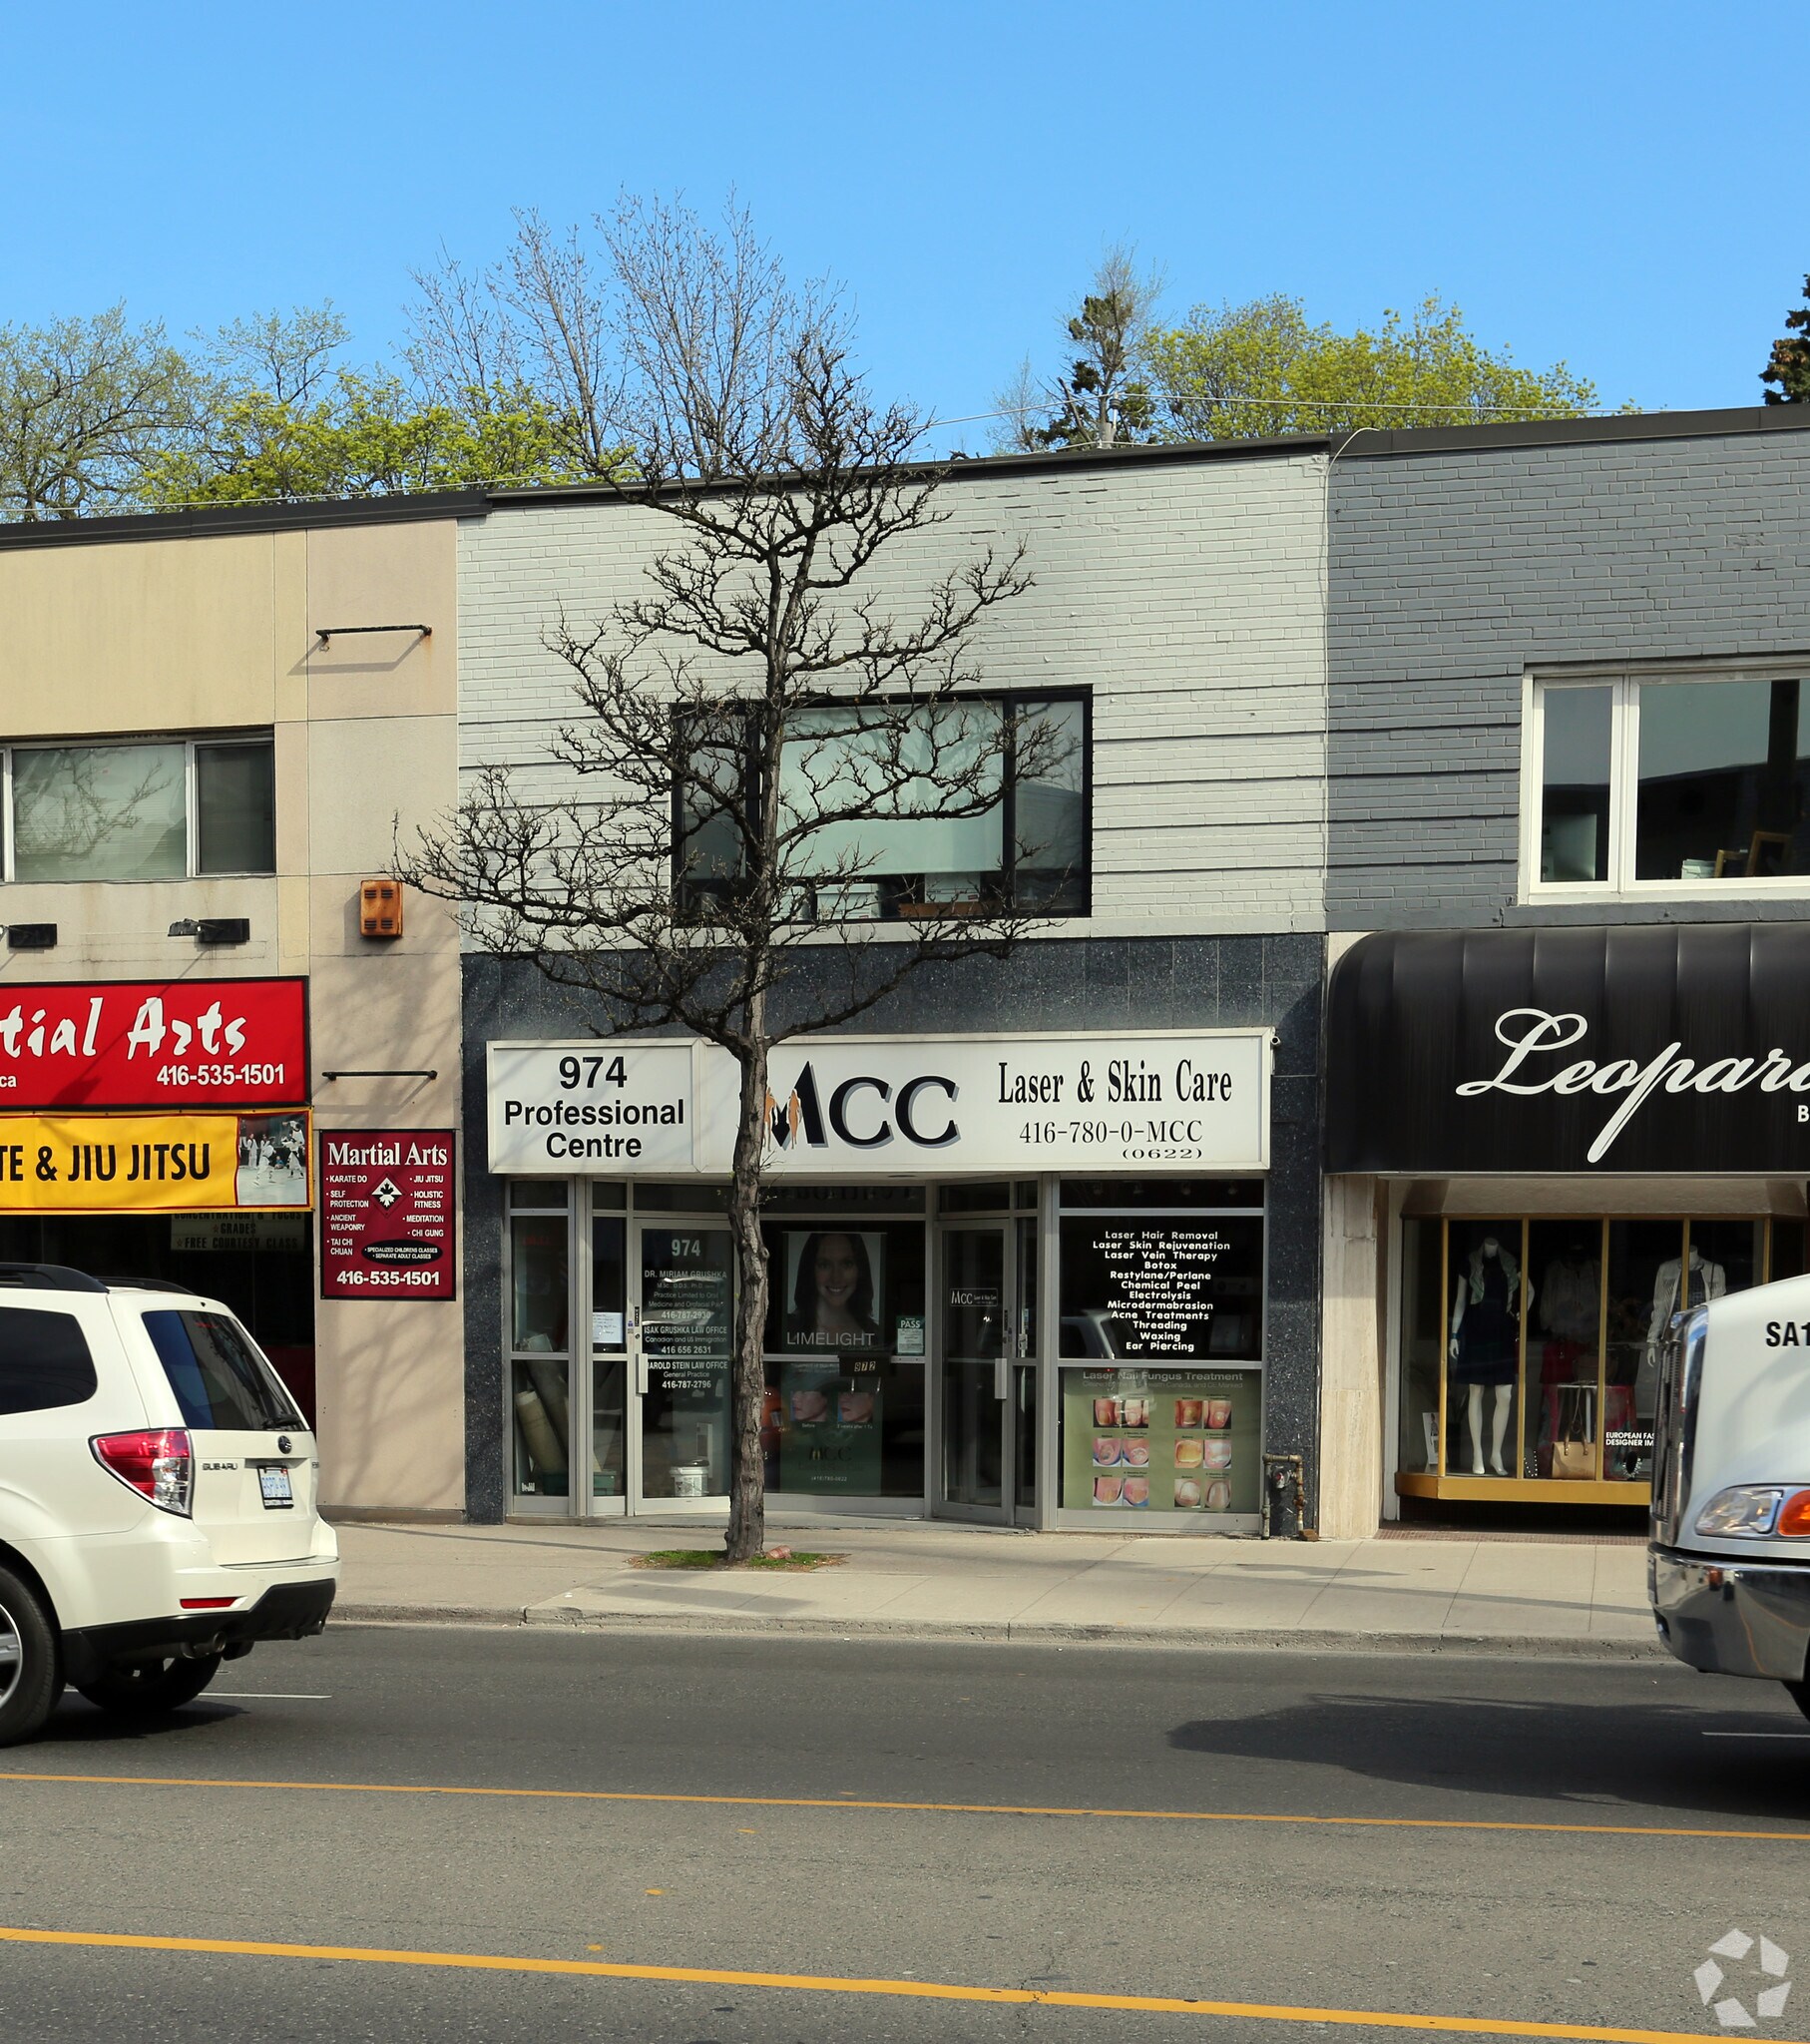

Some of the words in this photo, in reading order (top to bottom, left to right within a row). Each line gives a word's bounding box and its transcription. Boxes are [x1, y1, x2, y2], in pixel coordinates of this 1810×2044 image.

[128, 997, 247, 1060] Arts
[157, 1063, 284, 1086] 416-535-1501
[559, 1055, 628, 1090] 974
[999, 1061, 1064, 1104] Laser
[1077, 1060, 1096, 1101] &
[1109, 1059, 1162, 1103] Skin
[1175, 1058, 1233, 1102] Care
[766, 1060, 962, 1151] MCC
[504, 1099, 684, 1126] Professional
[1019, 1119, 1203, 1146] 416-780-0-MCC
[546, 1132, 643, 1159] Centre
[327, 1142, 401, 1166] Martial
[405, 1142, 448, 1166] Arts
[1122, 1148, 1203, 1160] (0622)
[36, 1146, 58, 1182] &
[68, 1144, 117, 1182] JIU
[128, 1143, 212, 1182] JITSU
[425, 1175, 444, 1184] JITSU
[330, 1190, 346, 1199] SELF
[330, 1200, 369, 1209] PROTECTION
[220, 1223, 256, 1235] GRADES
[1105, 1231, 1135, 1240] Laser
[1141, 1231, 1164, 1240] Hair
[1171, 1231, 1218, 1240] Removal
[185, 1237, 207, 1250] FREE
[213, 1238, 259, 1250] COURTESY
[266, 1238, 298, 1250] CLASS
[672, 1239, 701, 1257] 974
[1093, 1241, 1123, 1250] Laser
[1129, 1241, 1152, 1250] Skin
[1158, 1241, 1230, 1252] Rejuvenation
[1141, 1251, 1165, 1260] Vein
[1172, 1251, 1217, 1262] Therapy
[1144, 1261, 1177, 1270] Botox
[336, 1271, 440, 1285] 416-535-1501
[660, 1270, 688, 1278] MIRIAM
[1110, 1271, 1212, 1280] Restylane/Perlane
[1121, 1280, 1170, 1289] Chemical
[951, 1290, 973, 1304] MCC
[1129, 1290, 1191, 1300] Electrolysis
[1107, 1300, 1213, 1309] Microdermabrasion
[1145, 1310, 1209, 1319] Treatments
[900, 1319, 921, 1328] PASS
[1132, 1320, 1187, 1331] Threading
[786, 1331, 876, 1346] LIMELIGHT
[1139, 1331, 1181, 1342] Waxing
[1126, 1341, 1143, 1350] Ear
[1149, 1340, 1194, 1352] Piercing
[648, 1361, 672, 1370] AROLD
[1141, 1371, 1182, 1382] Fungus
[1184, 1371, 1243, 1381] Treatment
[203, 1462, 238, 1471] SUBARU
